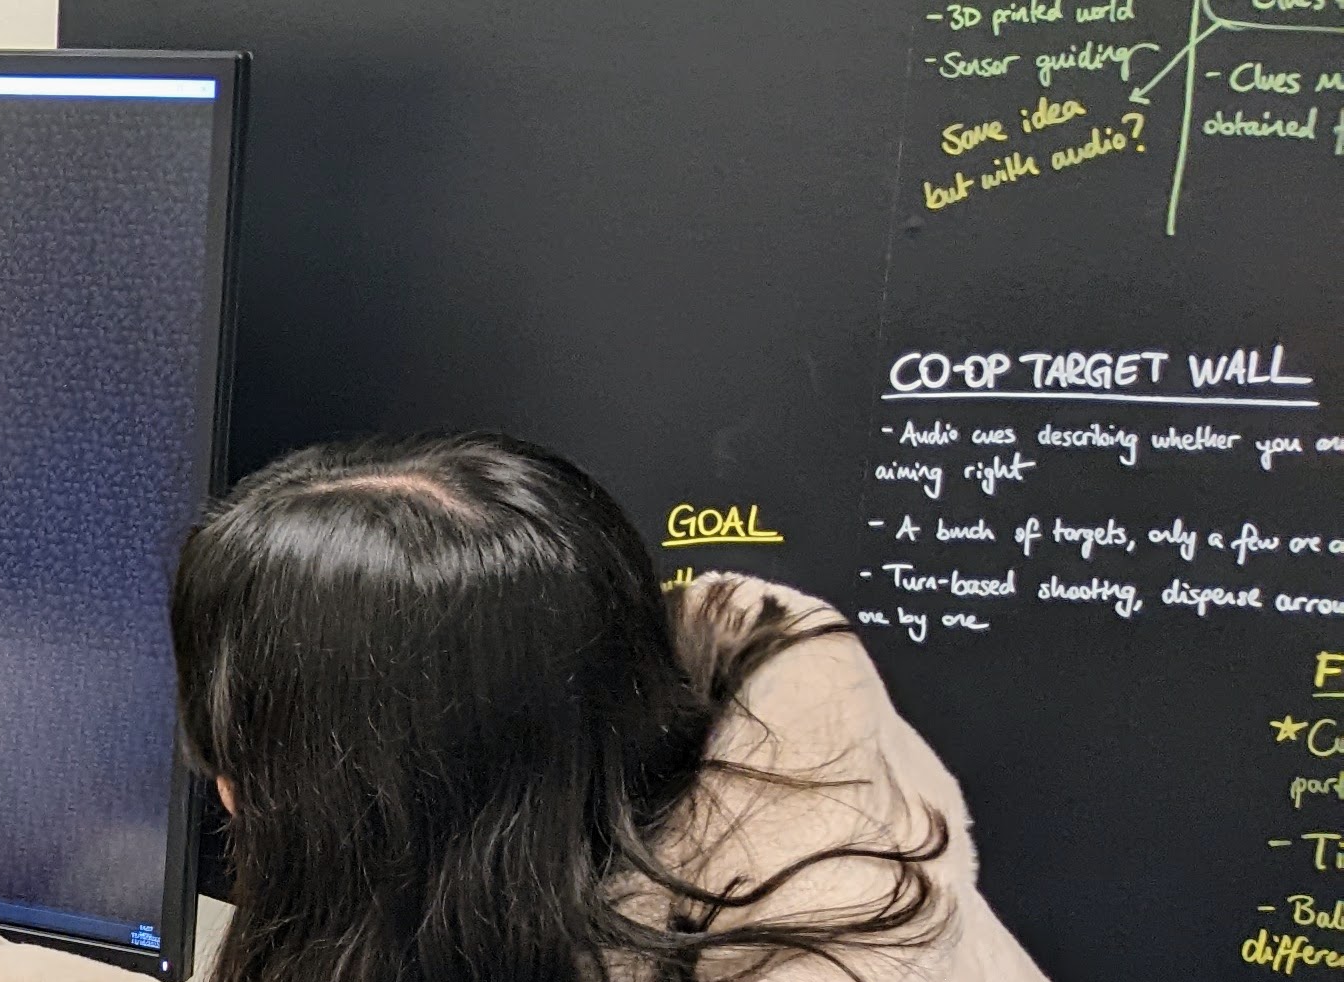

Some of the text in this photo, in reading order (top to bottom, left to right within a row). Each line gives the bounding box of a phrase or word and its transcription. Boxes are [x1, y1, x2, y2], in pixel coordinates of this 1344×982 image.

[948, 0, 1135, 35] 3D printed world
[939, 41, 1160, 86] Sensor guiding
[1229, 63, 1302, 94] Clues
[1020, 97, 1087, 134] idea
[1202, 106, 1317, 141] obtained
[923, 111, 1146, 211] but with audio?
[889, 344, 1314, 392] CO-OP TARGET WALL
[898, 421, 960, 447] Audio
[971, 426, 1018, 446] cues
[1037, 421, 1140, 467] describing
[1152, 424, 1242, 451] whether
[1255, 433, 1303, 471] you
[875, 452, 1037, 499] aiming right
[667, 503, 779, 539] GOAL
[894, 514, 922, 542] A
[936, 518, 996, 542] bunch
[1013, 516, 1043, 557] of
[1052, 518, 1136, 560] targets,
[1148, 518, 1199, 561] only
[1207, 530, 1224, 550] a
[1229, 522, 1281, 566] few
[881, 563, 1017, 597] Turn-based
[1036, 578, 1144, 618] shooting,
[1160, 579, 1264, 618] dispense
[857, 607, 991, 643] one by one
